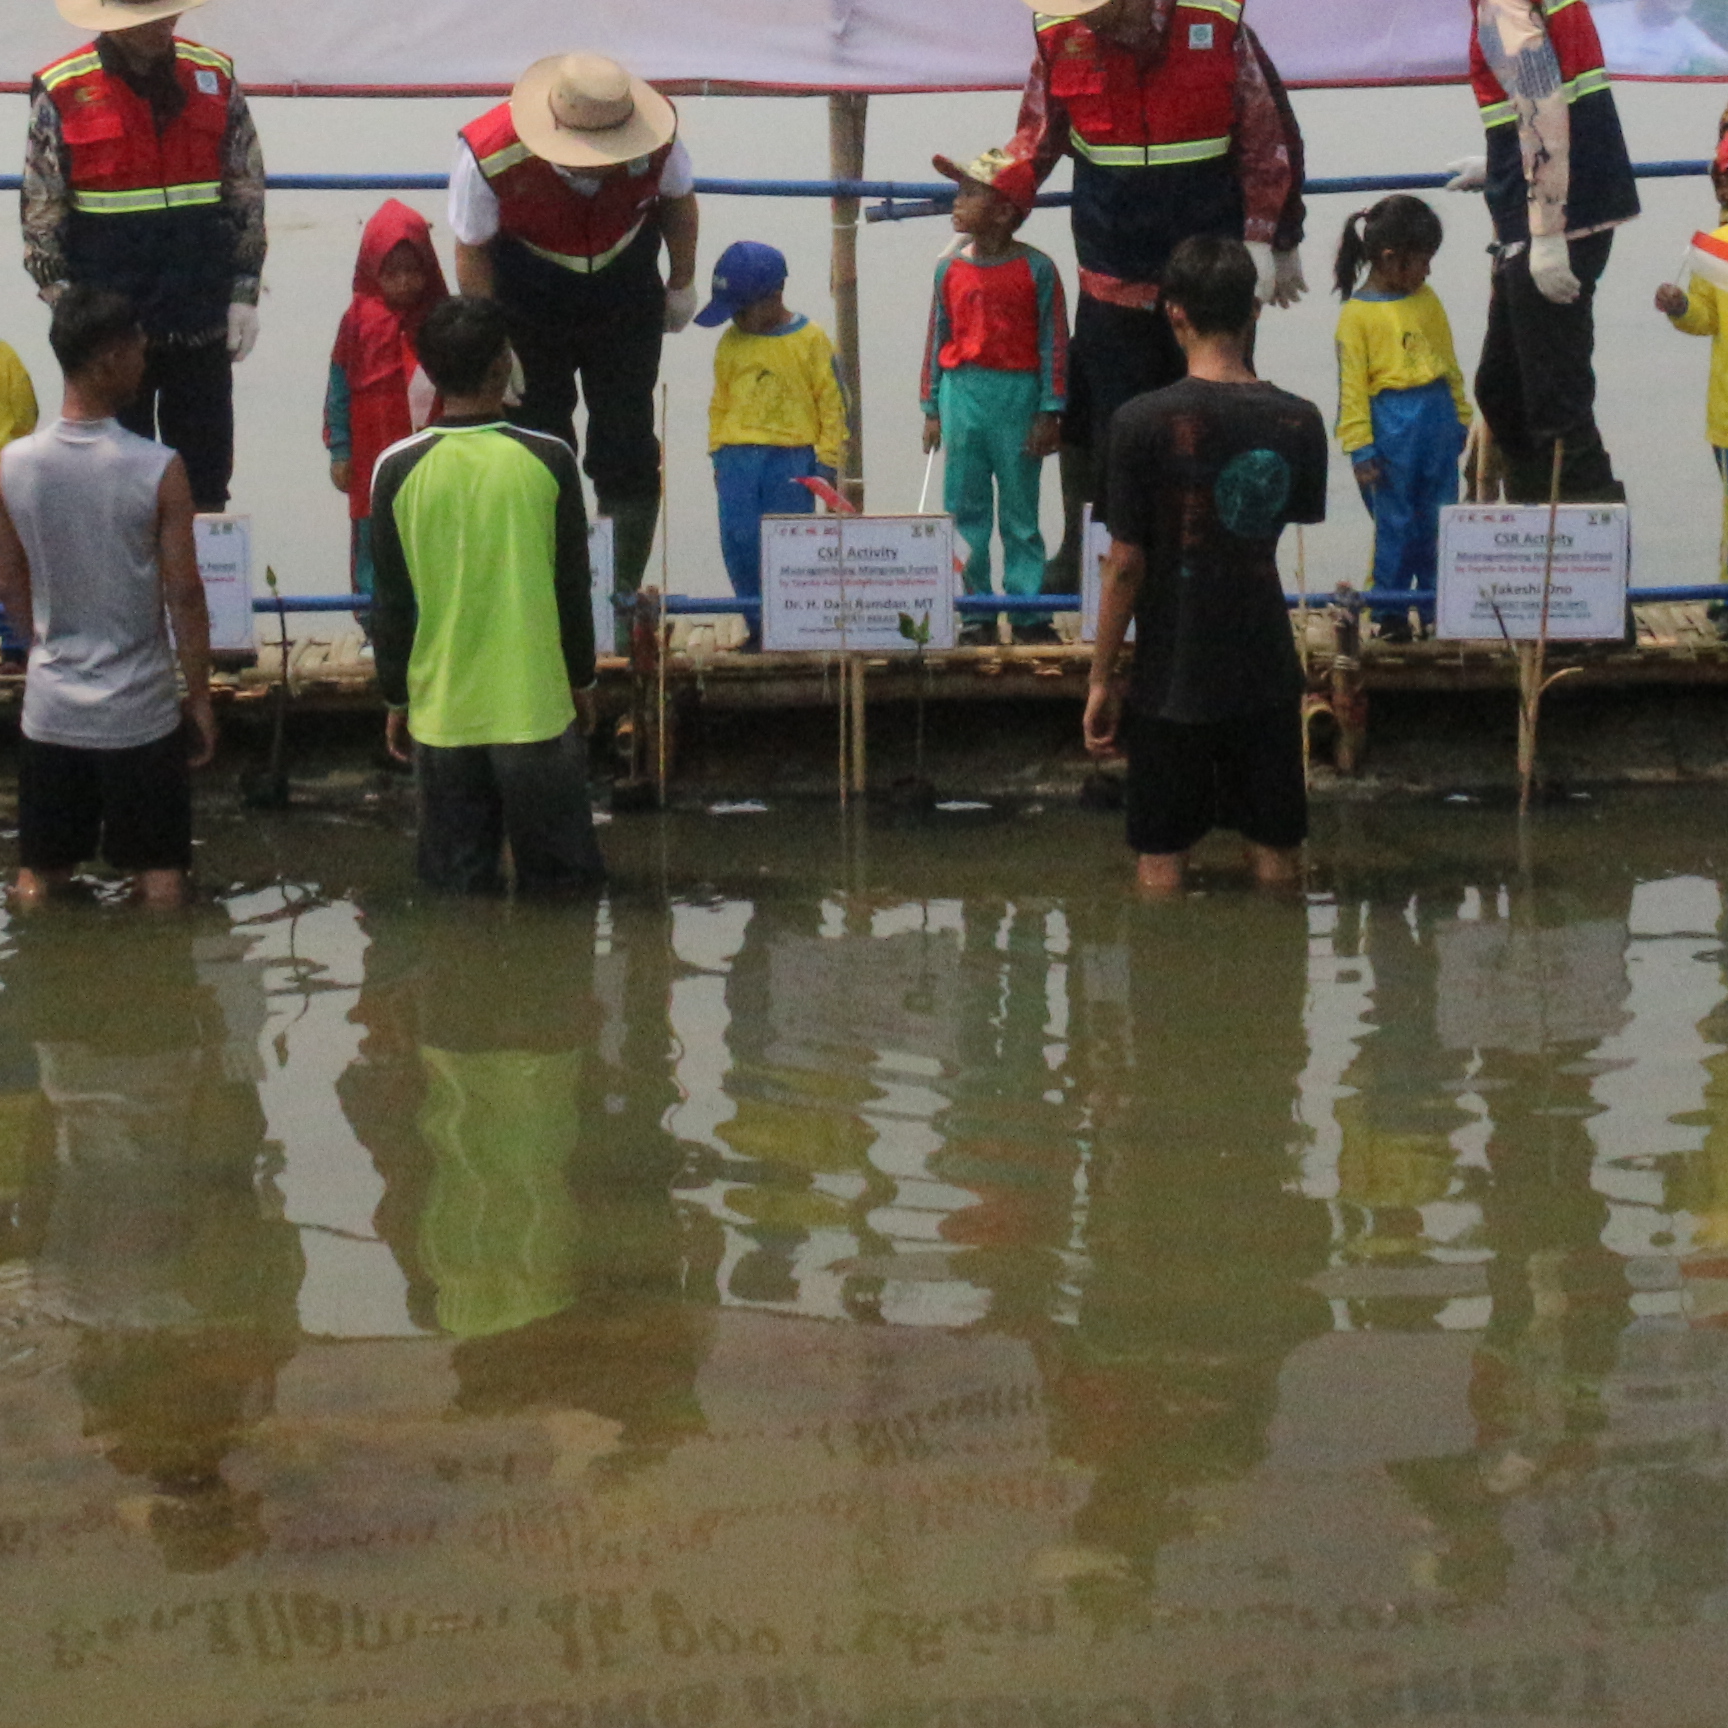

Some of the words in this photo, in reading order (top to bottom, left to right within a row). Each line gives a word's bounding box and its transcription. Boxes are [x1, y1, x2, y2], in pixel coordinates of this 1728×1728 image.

[1494, 532, 1520, 546] CSR
[847, 546, 898, 561] Activity
[784, 598, 803, 610] Dr.
[914, 597, 935, 610] MT
